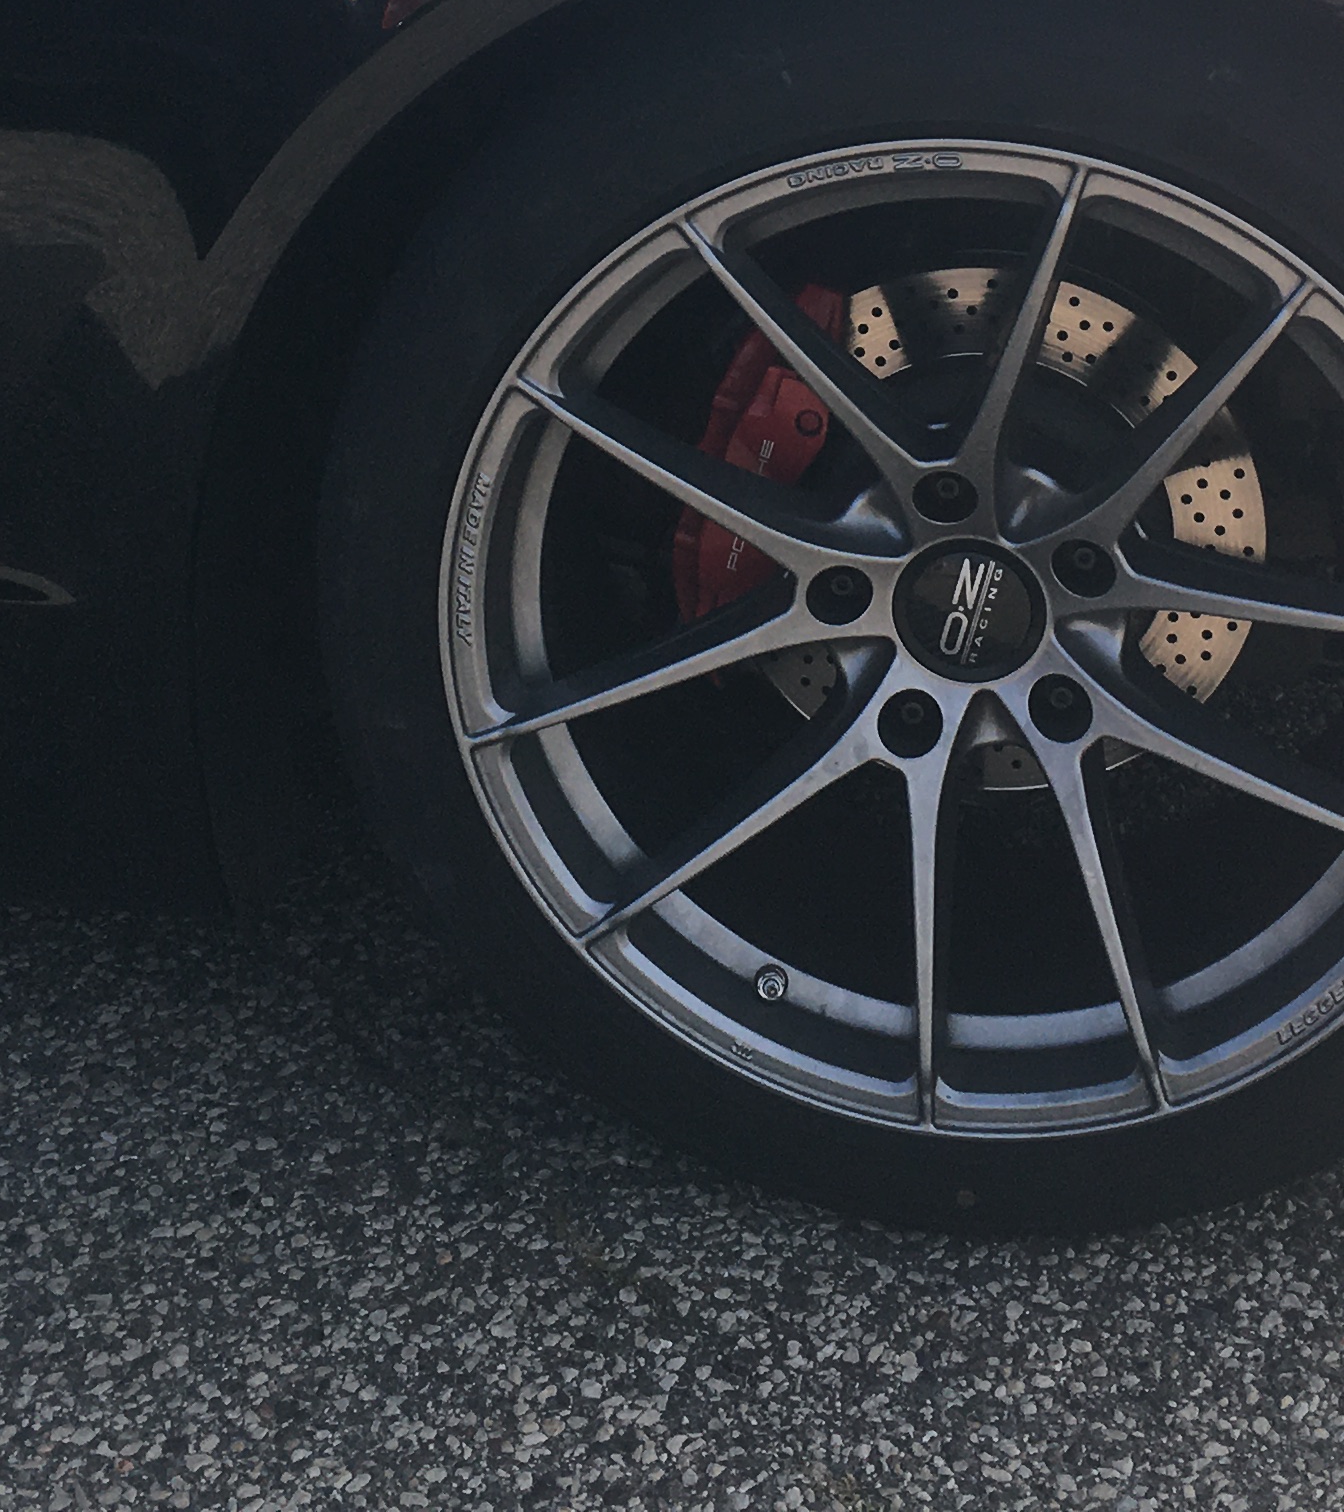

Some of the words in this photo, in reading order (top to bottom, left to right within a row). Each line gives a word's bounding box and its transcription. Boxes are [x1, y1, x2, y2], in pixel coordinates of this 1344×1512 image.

[786, 156, 885, 188] RACING
[462, 472, 491, 547] MADE
[458, 545, 476, 576] IN
[456, 574, 473, 647] ITALY
[968, 568, 1004, 664] RACING
